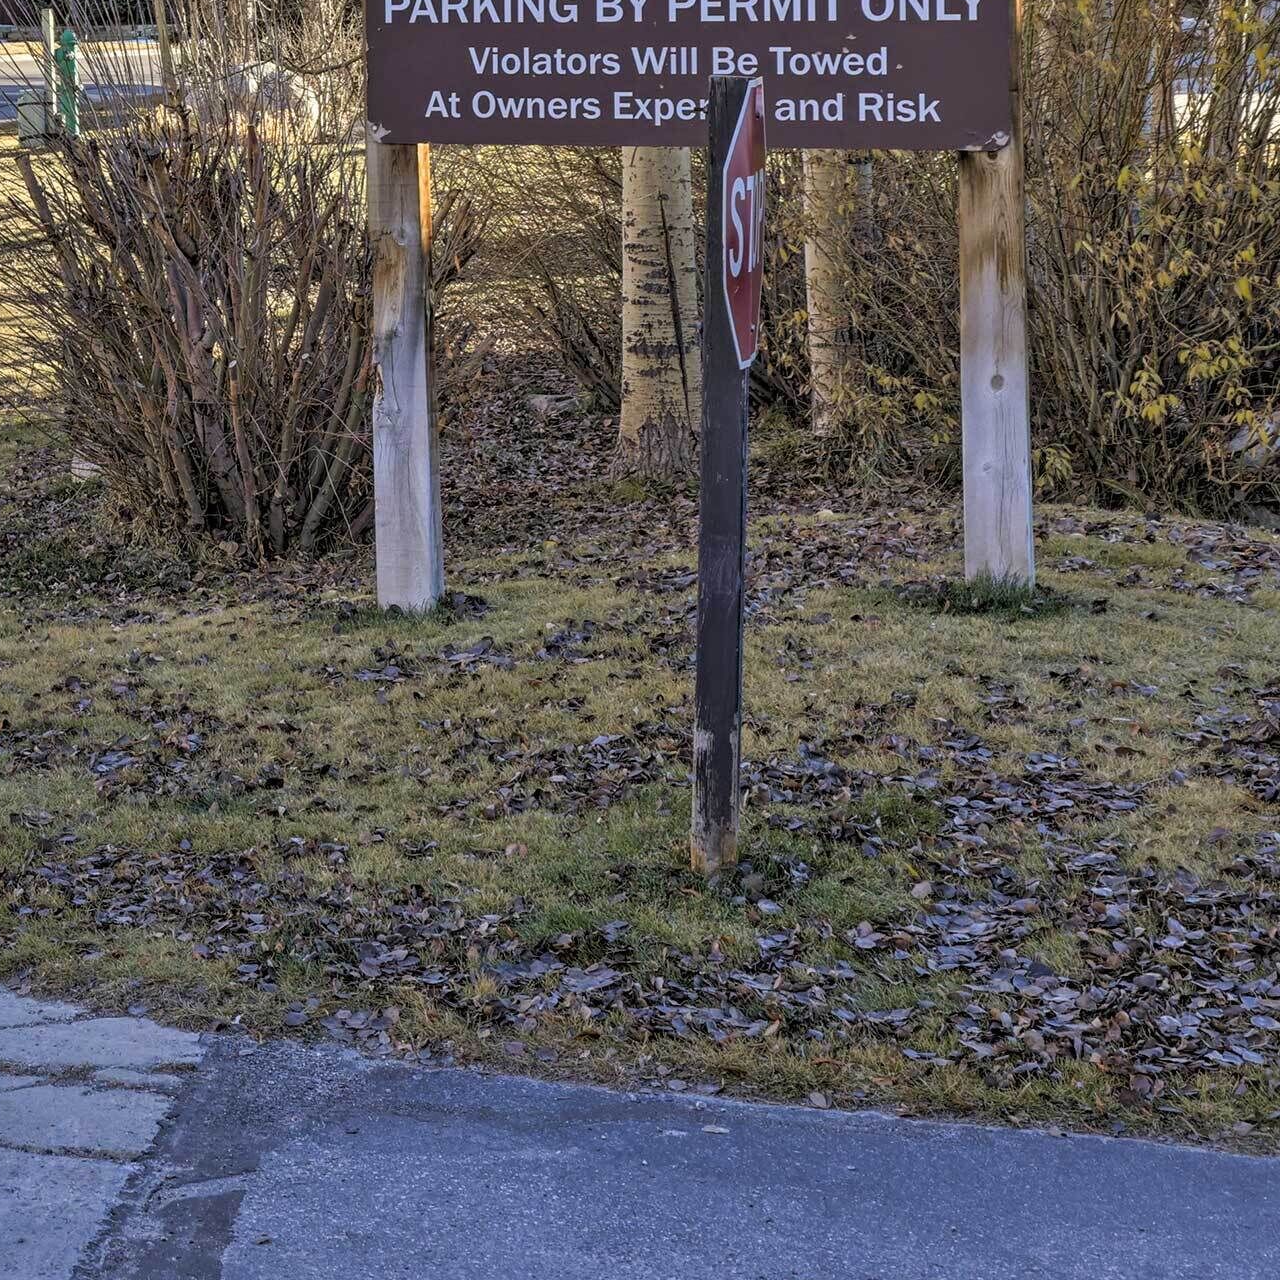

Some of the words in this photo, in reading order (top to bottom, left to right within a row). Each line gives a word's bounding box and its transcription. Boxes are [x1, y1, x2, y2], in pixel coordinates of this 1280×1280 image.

[469, 47, 620, 75] Violators
[631, 47, 698, 75] Will
[711, 47, 758, 75] Be
[769, 46, 888, 76] Towed
[425, 90, 461, 119] At
[473, 90, 600, 120] Owners
[774, 93, 844, 122] and
[858, 93, 942, 122] Risk
[729, 168, 764, 278] STOP
